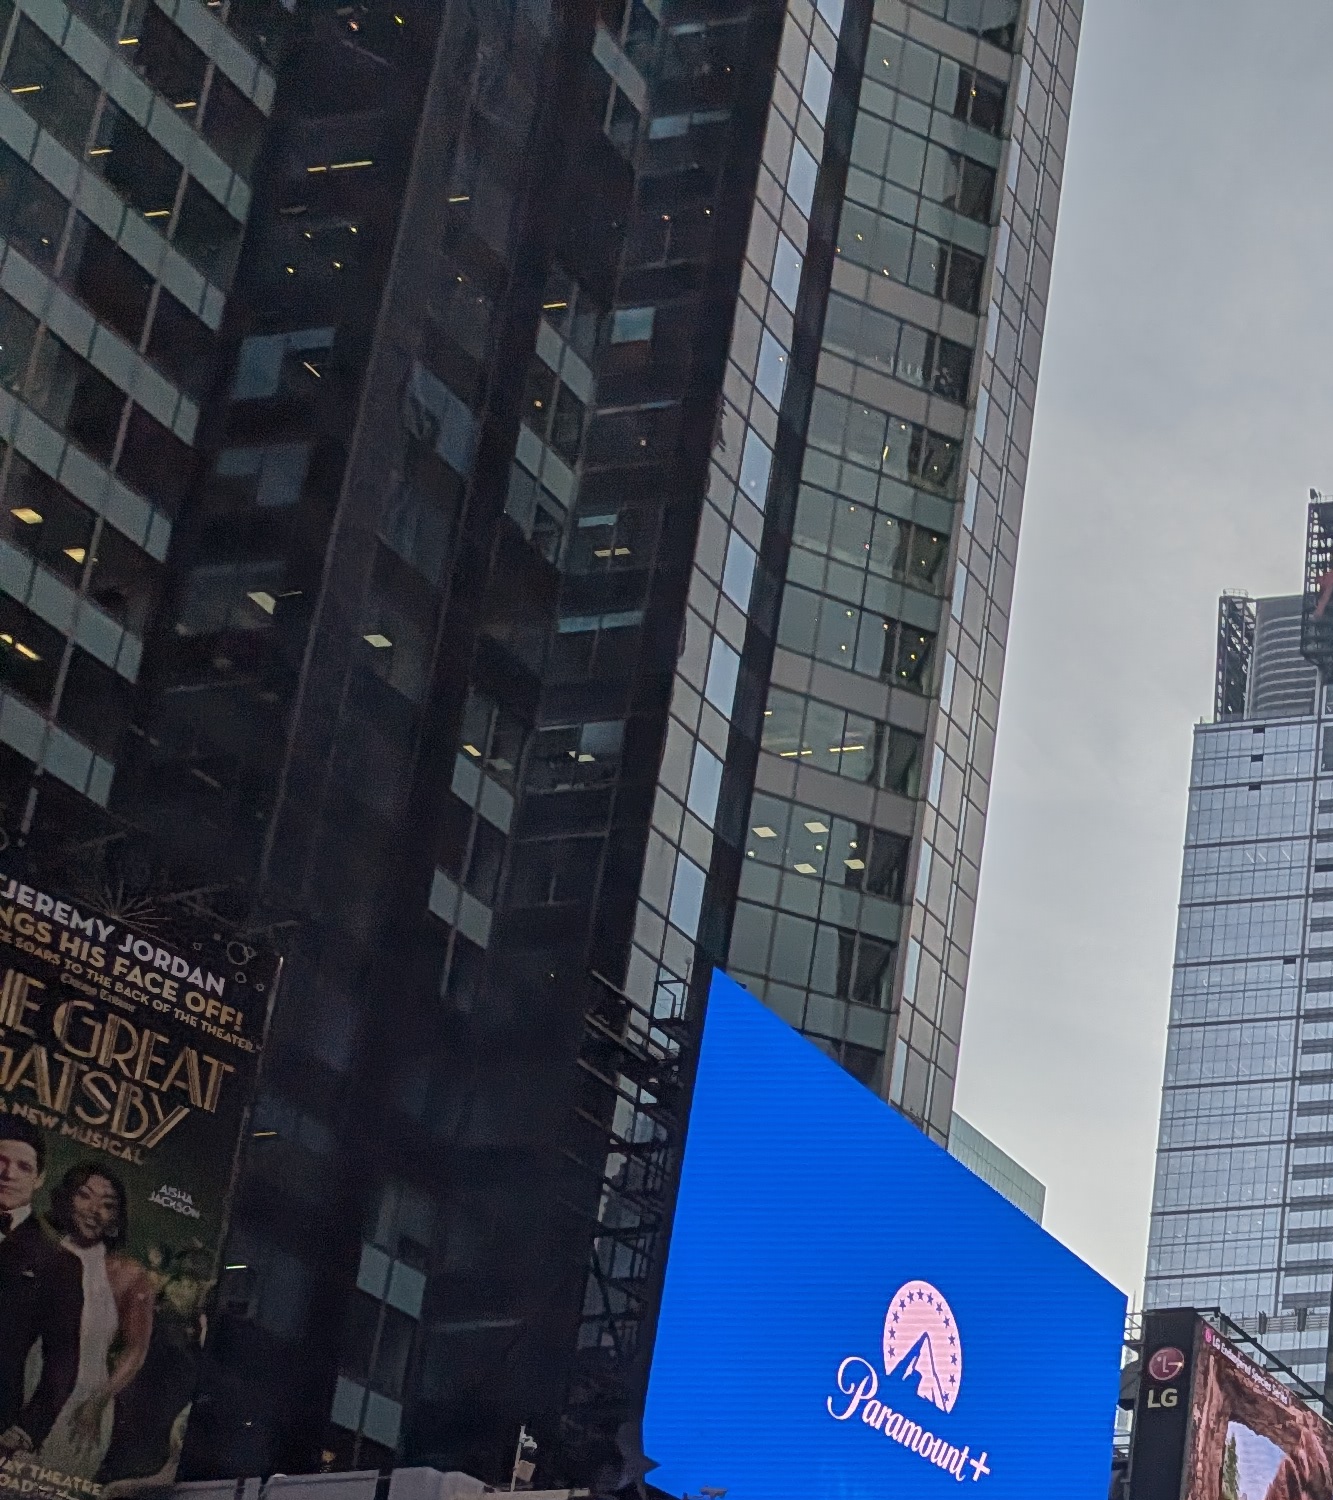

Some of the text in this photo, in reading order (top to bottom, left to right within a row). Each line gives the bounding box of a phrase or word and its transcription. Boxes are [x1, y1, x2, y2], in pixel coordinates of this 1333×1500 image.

[59, 929, 107, 968] HIS
[112, 958, 180, 1002] FACE
[185, 991, 245, 1032] OFF!
[64, 958, 83, 975] TO
[86, 968, 112, 988] THE
[114, 979, 150, 1006] BACK
[152, 998, 172, 1014] OF
[173, 1007, 198, 1027] THE
[117, 933, 226, 997] JORDAN
[54, 1000, 236, 1113] GREAT
[12, 1103, 58, 1130] NEW
[60, 1122, 145, 1166] MUSICAL
[150, 1193, 200, 1219] JACKSON
[827, 1355, 990, 1482] Paramount+
[1147, 1389, 1178, 1408] LG
[25, 1465, 102, 1496] THEATRE
